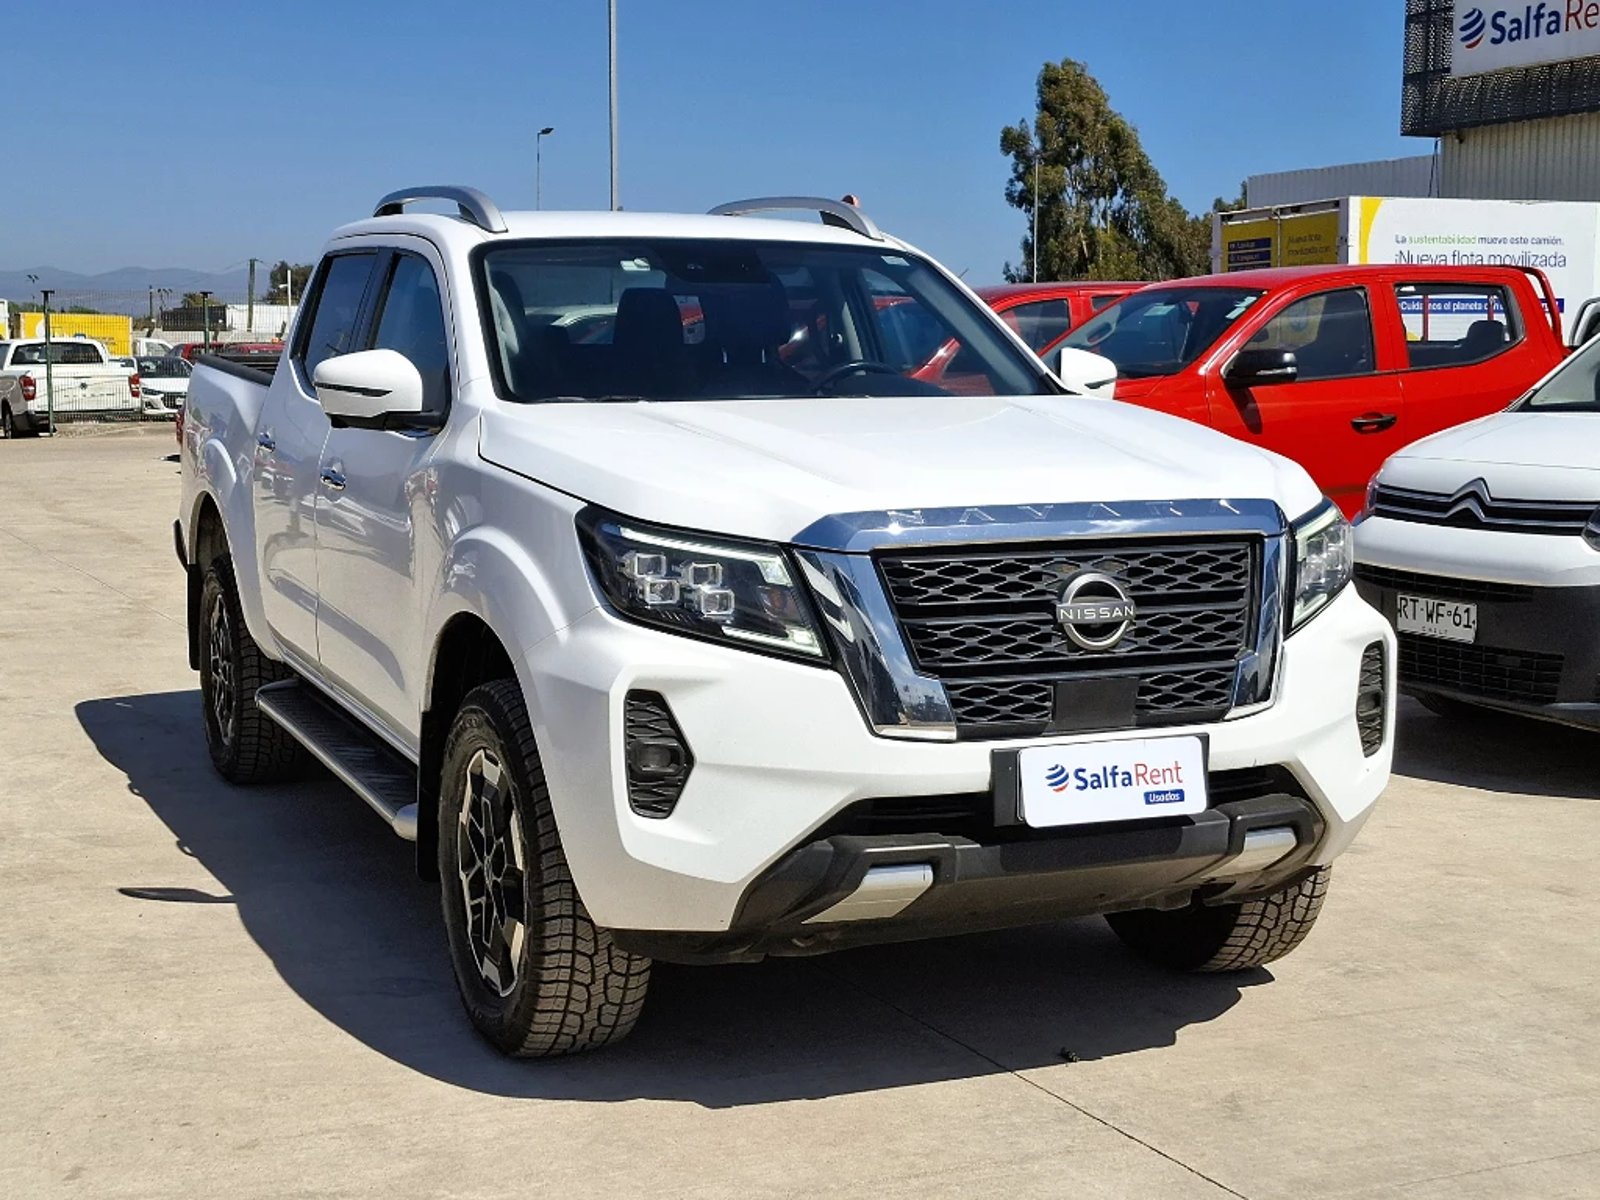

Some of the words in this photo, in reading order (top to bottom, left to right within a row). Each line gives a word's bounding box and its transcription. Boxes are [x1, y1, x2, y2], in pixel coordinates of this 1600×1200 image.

[1394, 234, 1407, 244] La
[1408, 233, 1476, 245] sustentabilidad
[1477, 236, 1508, 245] mueve
[1509, 235, 1529, 245] este
[1530, 235, 1565, 246] camión.
[1451, 249, 1484, 266] flota
[1488, 251, 1567, 268] movilizada
[1059, 605, 1135, 621] NISSAN
[1073, 760, 1184, 791] SalfaRent
[1149, 791, 1181, 803] Usados
